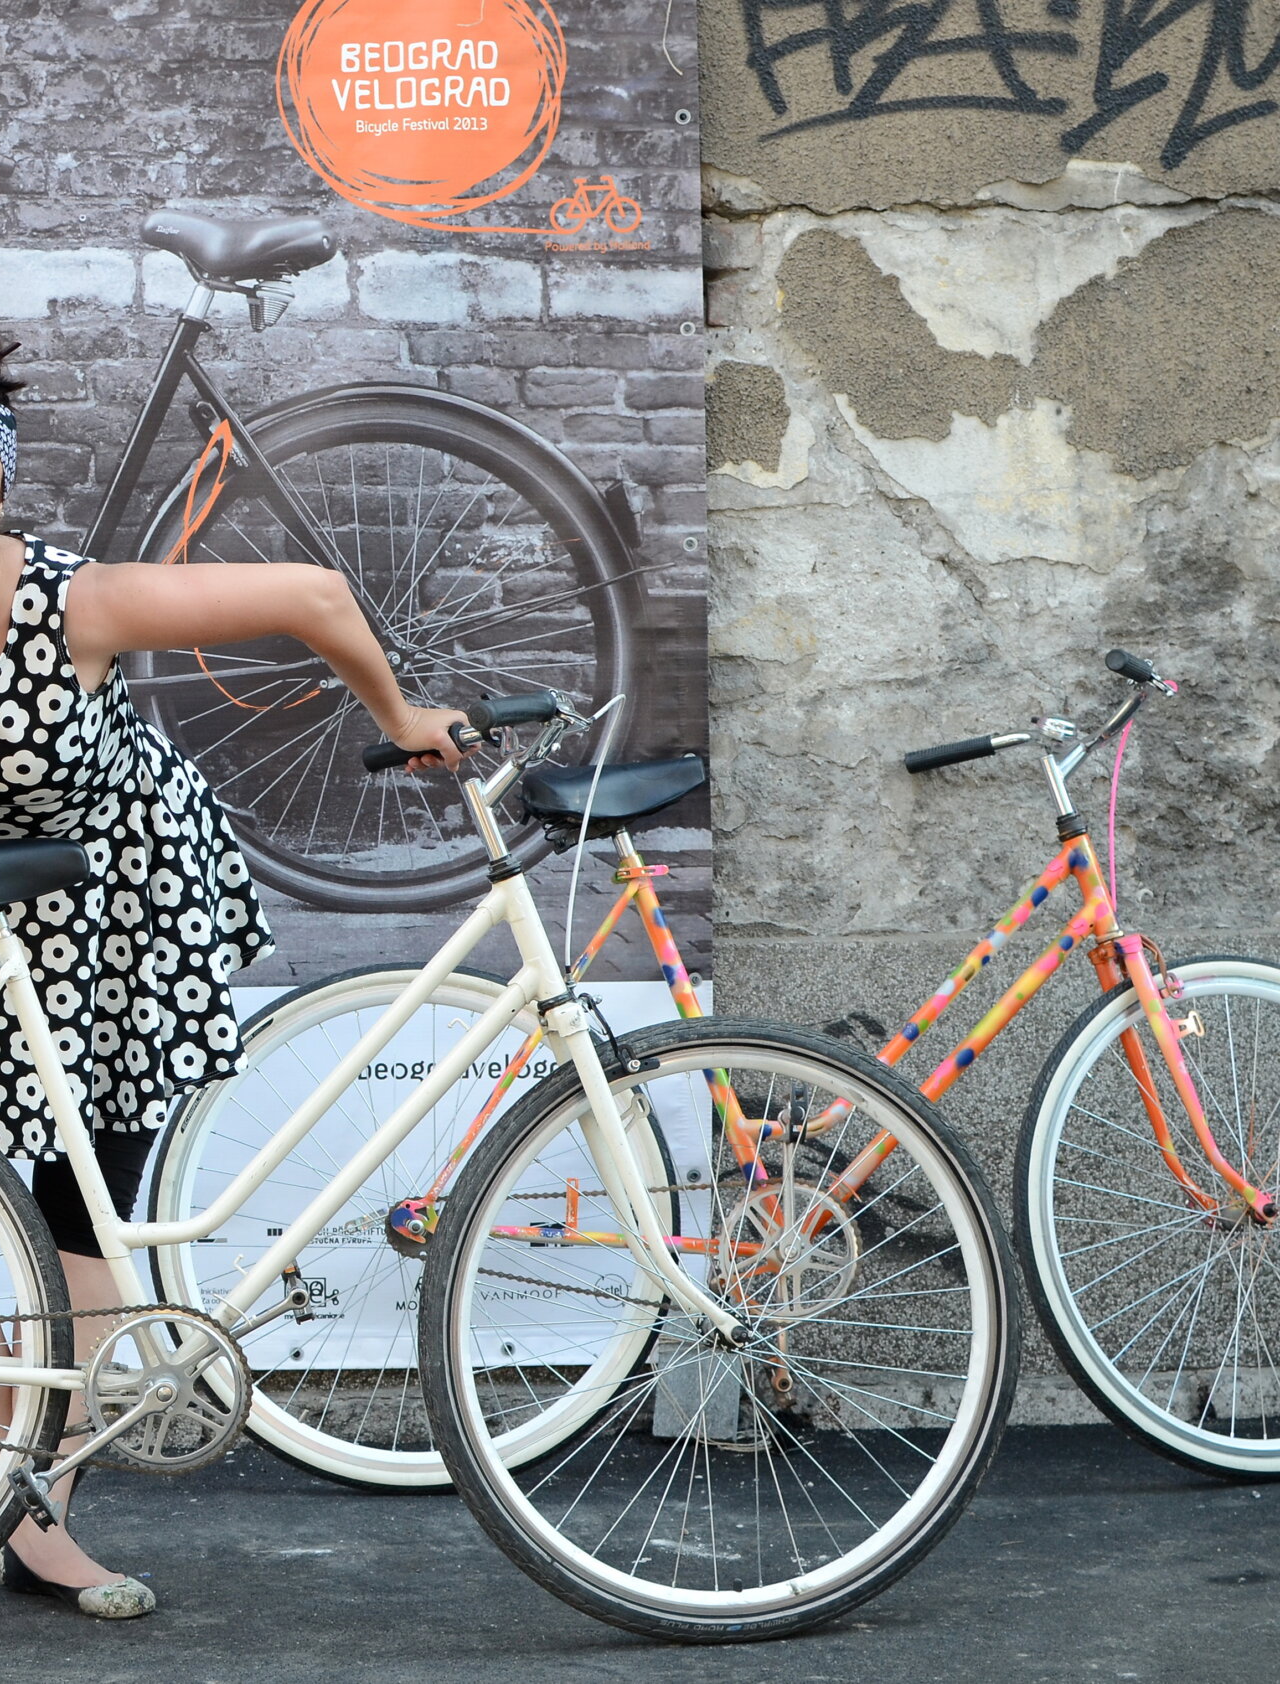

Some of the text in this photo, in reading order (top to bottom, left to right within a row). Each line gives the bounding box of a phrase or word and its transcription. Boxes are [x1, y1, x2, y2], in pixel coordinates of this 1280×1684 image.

[341, 39, 498, 73] BEOGRAD
[331, 76, 510, 112] VELOGRAD
[356, 116, 488, 136] Bicycle Festival 2013
[545, 240, 592, 252] Powered
[593, 241, 607, 254] by
